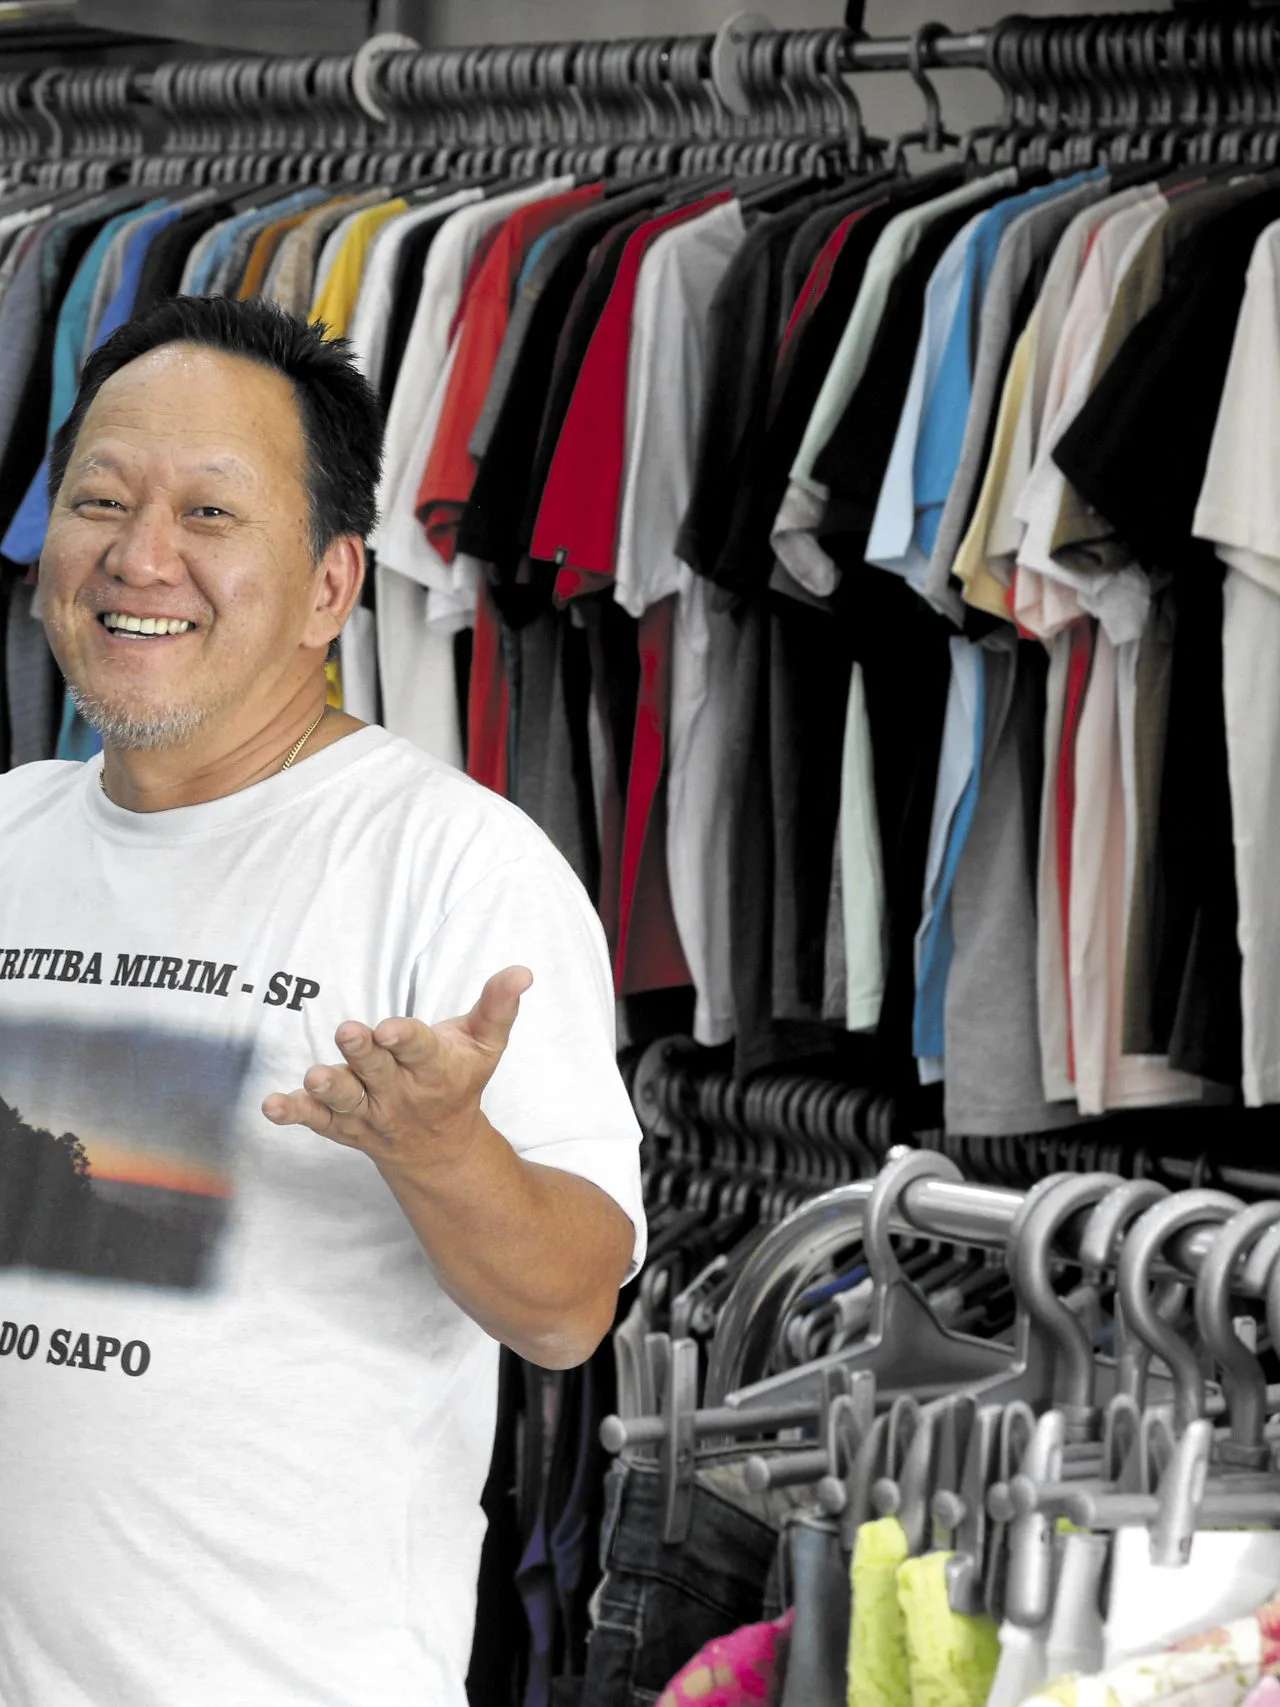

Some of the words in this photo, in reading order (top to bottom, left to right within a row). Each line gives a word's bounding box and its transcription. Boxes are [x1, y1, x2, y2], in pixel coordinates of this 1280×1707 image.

[110, 953, 238, 997] MIRIM
[241, 983, 255, 994] -
[263, 970, 321, 1012] SP
[46, 1328, 151, 1377] SAPO
